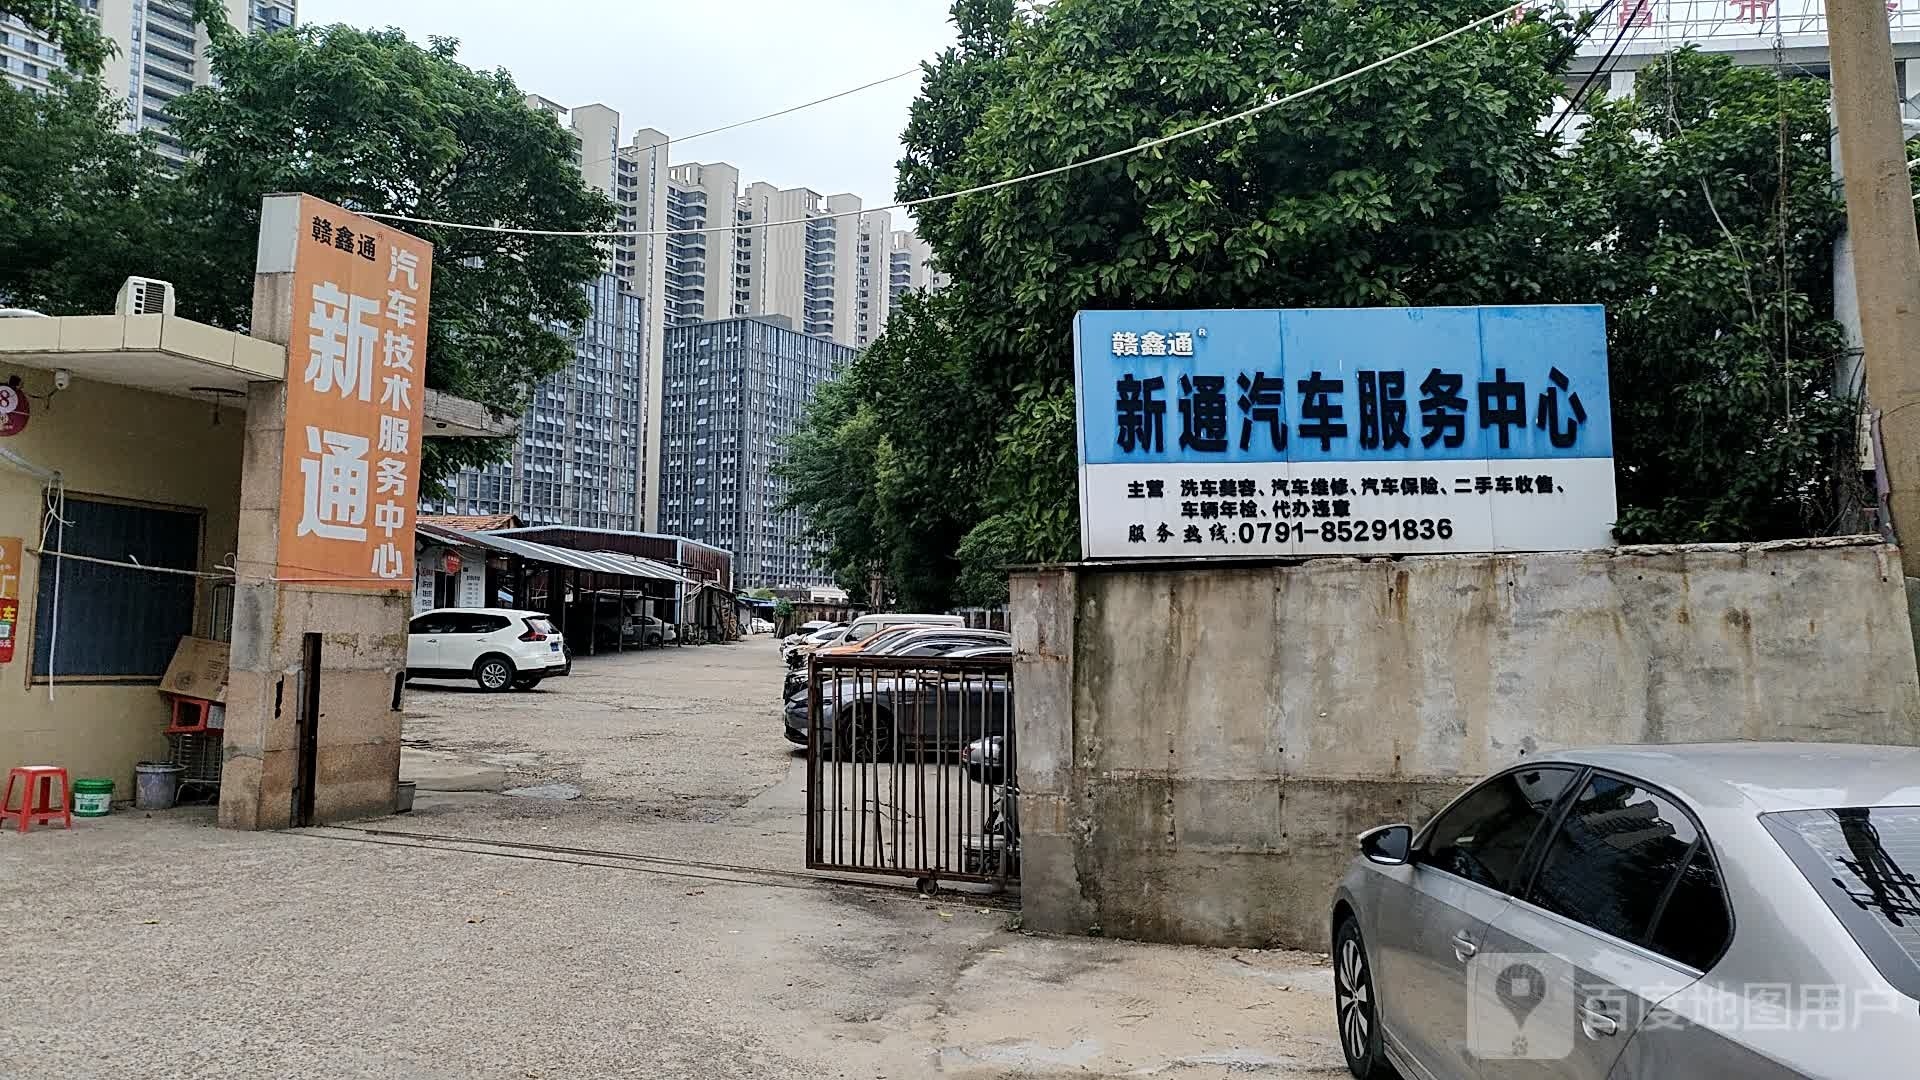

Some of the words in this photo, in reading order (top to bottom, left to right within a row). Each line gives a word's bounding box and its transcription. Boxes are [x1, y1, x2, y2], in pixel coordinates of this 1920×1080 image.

[311, 215, 376, 262] 赣鑫通
[1112, 331, 1194, 357] 赣鑫通
[297, 280, 381, 542] 新通
[371, 246, 419, 579] 汽车技术服务中心
[1116, 365, 1588, 453] 新通汽车服务中心
[1127, 480, 1165, 499] 主营
